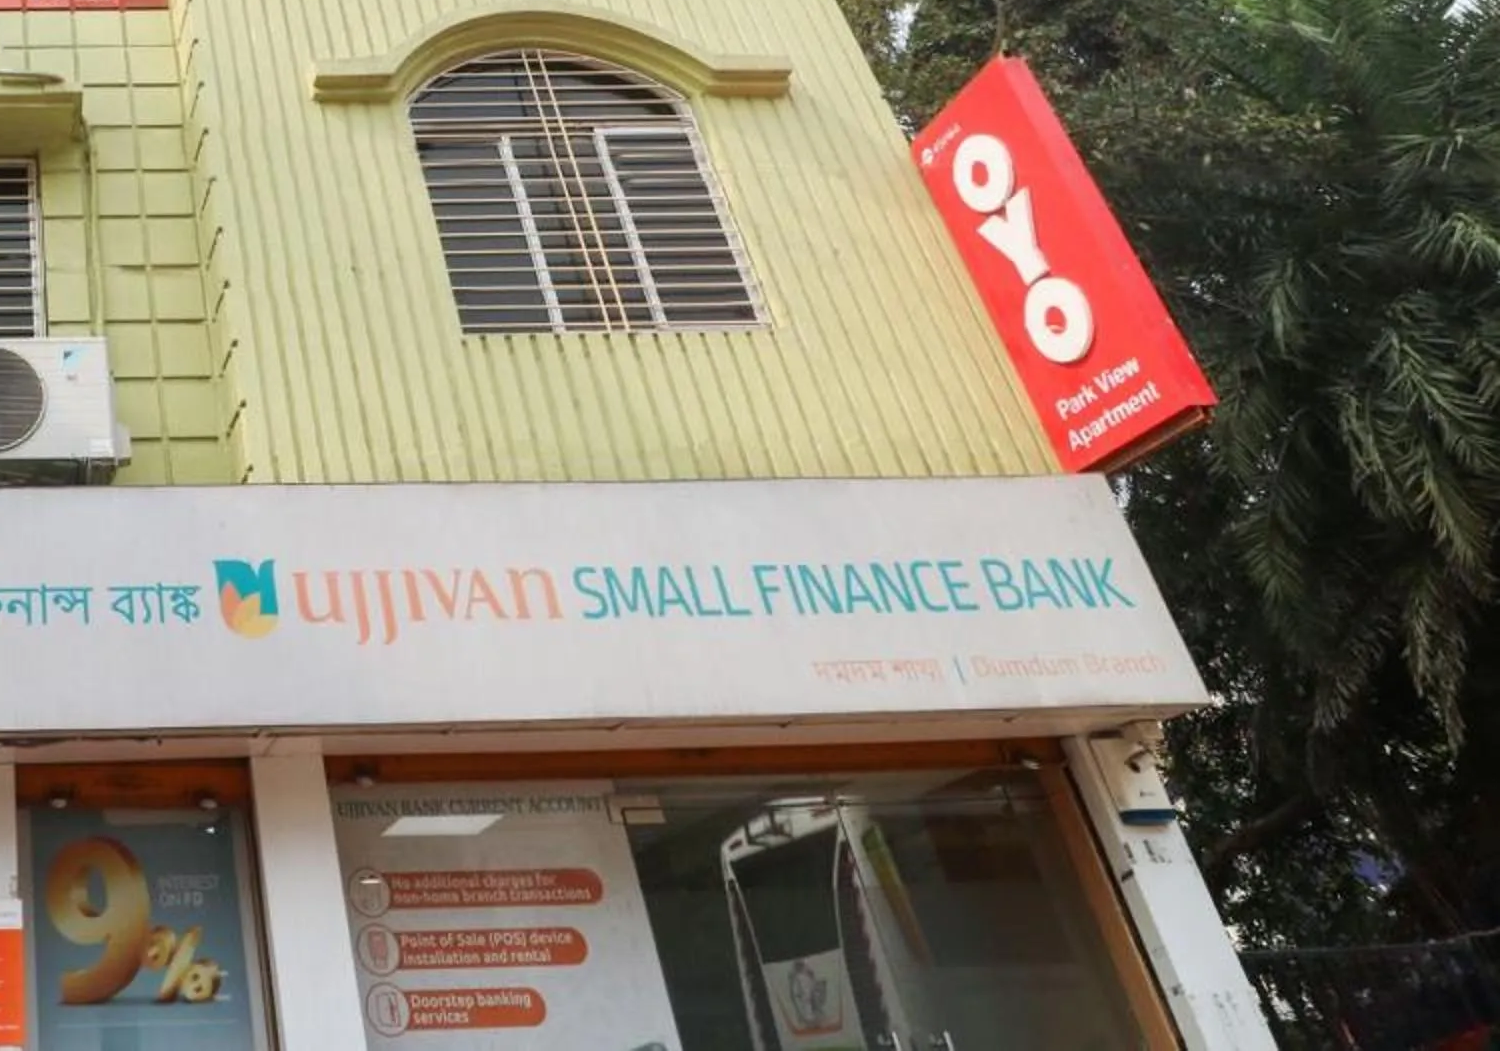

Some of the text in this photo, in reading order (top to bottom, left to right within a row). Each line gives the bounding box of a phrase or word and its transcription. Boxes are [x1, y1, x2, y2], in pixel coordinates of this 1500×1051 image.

[953, 133, 1095, 363] OYO
[1054, 355, 1141, 421] Park View
[1066, 381, 1161, 452] Apartment
[572, 563, 754, 620] SMALL
[751, 560, 981, 616] FINANCE
[980, 557, 1137, 613] BANK
[970, 651, 1167, 680] Dumdum Branch
[400, 930, 574, 949] Point of Sale (POS) device
[483, 949, 509, 964] and
[510, 947, 552, 963] rental
[411, 991, 532, 1011] Doorstep banking
[413, 1009, 470, 1025] services
